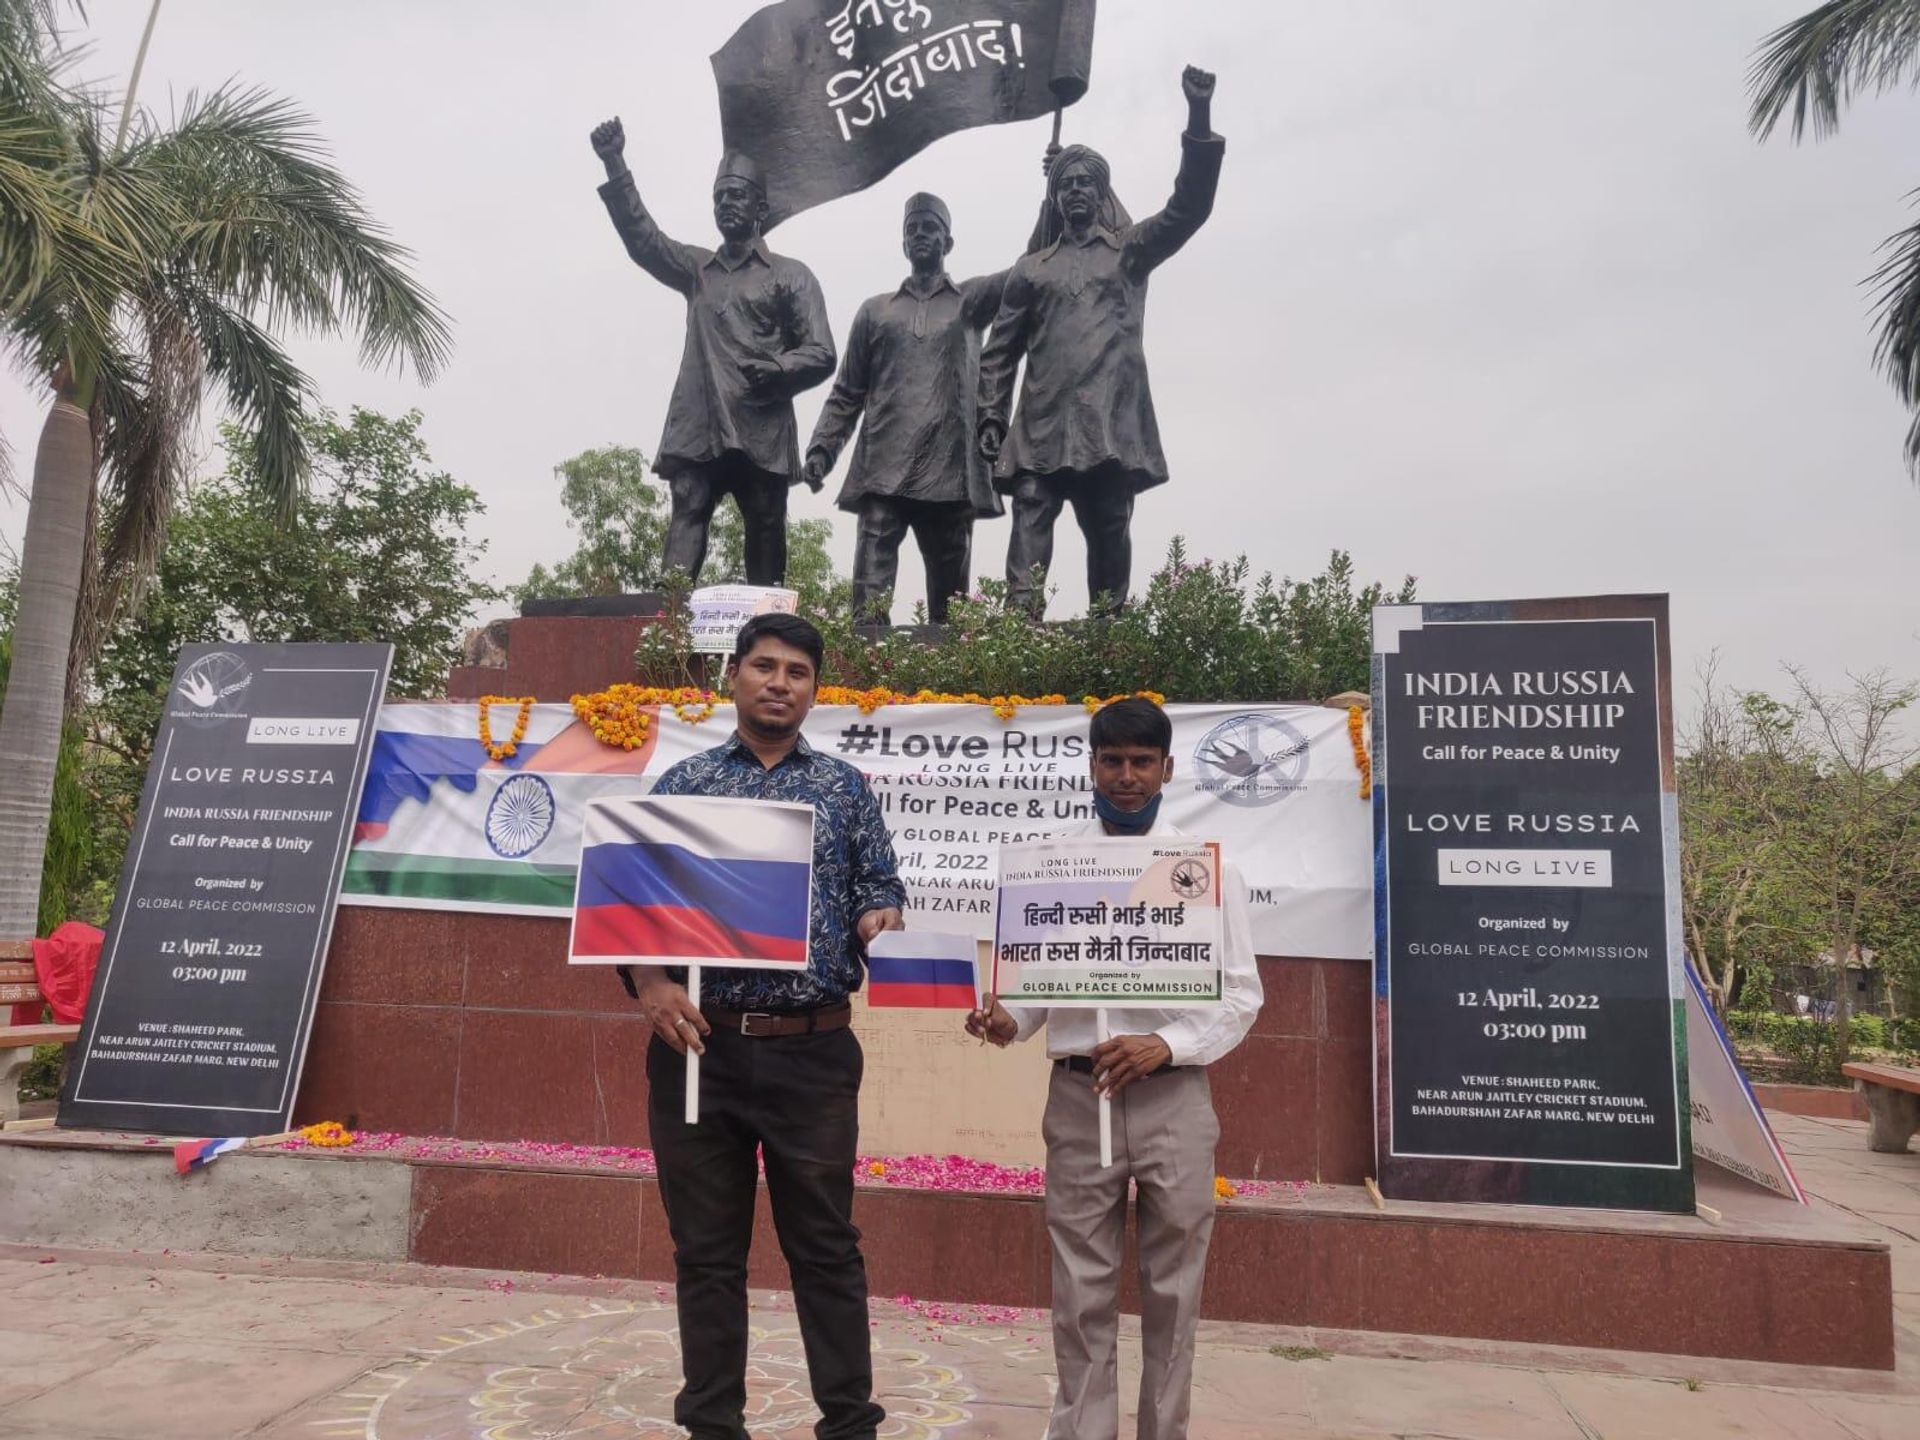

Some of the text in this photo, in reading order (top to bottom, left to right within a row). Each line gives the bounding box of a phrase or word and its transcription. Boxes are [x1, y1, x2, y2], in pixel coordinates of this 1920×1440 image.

[1404, 670, 1635, 696] INDIA RUSSIA
[1418, 704, 1625, 729] FRIENDSHIP
[254, 726, 348, 737] LONG LIVE
[836, 723, 1084, 760] #Love Rus
[1422, 745, 1620, 764] Call for Peace & Unity
[171, 767, 335, 784] LOVE RUSSIA
[922, 763, 1058, 773] LONG LIVE
[899, 773, 990, 789] RUSSIA
[999, 775, 1095, 792] FRIEND
[164, 806, 333, 822] INDIA RUSSIA FRIENDSHIP
[899, 793, 936, 814] for
[944, 795, 1018, 818] Peace
[1026, 799, 1044, 818] &
[1054, 799, 1097, 819] Uni
[1407, 814, 1641, 833] LOVE RUSSIA
[170, 834, 313, 853] Call for Peace & Unity
[904, 828, 980, 843] GLOBAL
[900, 852, 988, 870] ril, 2022
[1041, 857, 1097, 868] LONG LIVE
[1450, 860, 1597, 875] LONG LIVE
[1005, 867, 1143, 881] INDIA RUSSIA FRIENDSHIP
[195, 877, 264, 891] Organized by
[905, 876, 995, 891] NEAR ARU
[137, 898, 316, 914] GLOBAL PEACE COMMISSION
[932, 897, 992, 914] ZAFAR
[1024, 902, 1065, 927] हिन्दी
[1113, 901, 1148, 927] भाई
[1151, 901, 1185, 927] भाई
[1478, 917, 1569, 933] Organized by
[160, 940, 176, 953] 12
[225, 943, 263, 957] 2022
[1001, 941, 1043, 963] भारत
[1084, 935, 1124, 962] मैत्री
[1126, 936, 1213, 963] जिन्दाबाद
[1408, 943, 1649, 959] GLOBAL PEACE COMMISSION
[172, 965, 247, 984] 03:00 pm
[1089, 971, 1141, 981] Organized by
[1023, 983, 1213, 993] GLOBAL PEACE COMMISSION
[1458, 988, 1600, 1012] 12 April, 2022
[1483, 1022, 1587, 1043] 03:00 pm
[99, 1035, 124, 1046] NEAR
[124, 1036, 151, 1047] ARUN
[152, 1038, 190, 1049] JAITLEY
[190, 1040, 231, 1051] CRICKET
[91, 1050, 161, 1063] BAHADURSHAH
[161, 1053, 193, 1064] ZAFAR
[226, 1057, 250, 1067] NEW
[250, 1058, 280, 1069] DELHI
[1506, 1077, 1561, 1089] SHAHEED
[1417, 1089, 1448, 1100] NEAR
[1451, 1090, 1483, 1101] ARUN
[1486, 1092, 1533, 1104] JAITLEY
[1535, 1094, 1586, 1105] CRICKET
[1412, 1105, 1500, 1118] BAHADURSHAH
[1503, 1108, 1542, 1119] ZAFAR
[1587, 1112, 1615, 1123] NEW
[1618, 1113, 1655, 1125] DELHI
